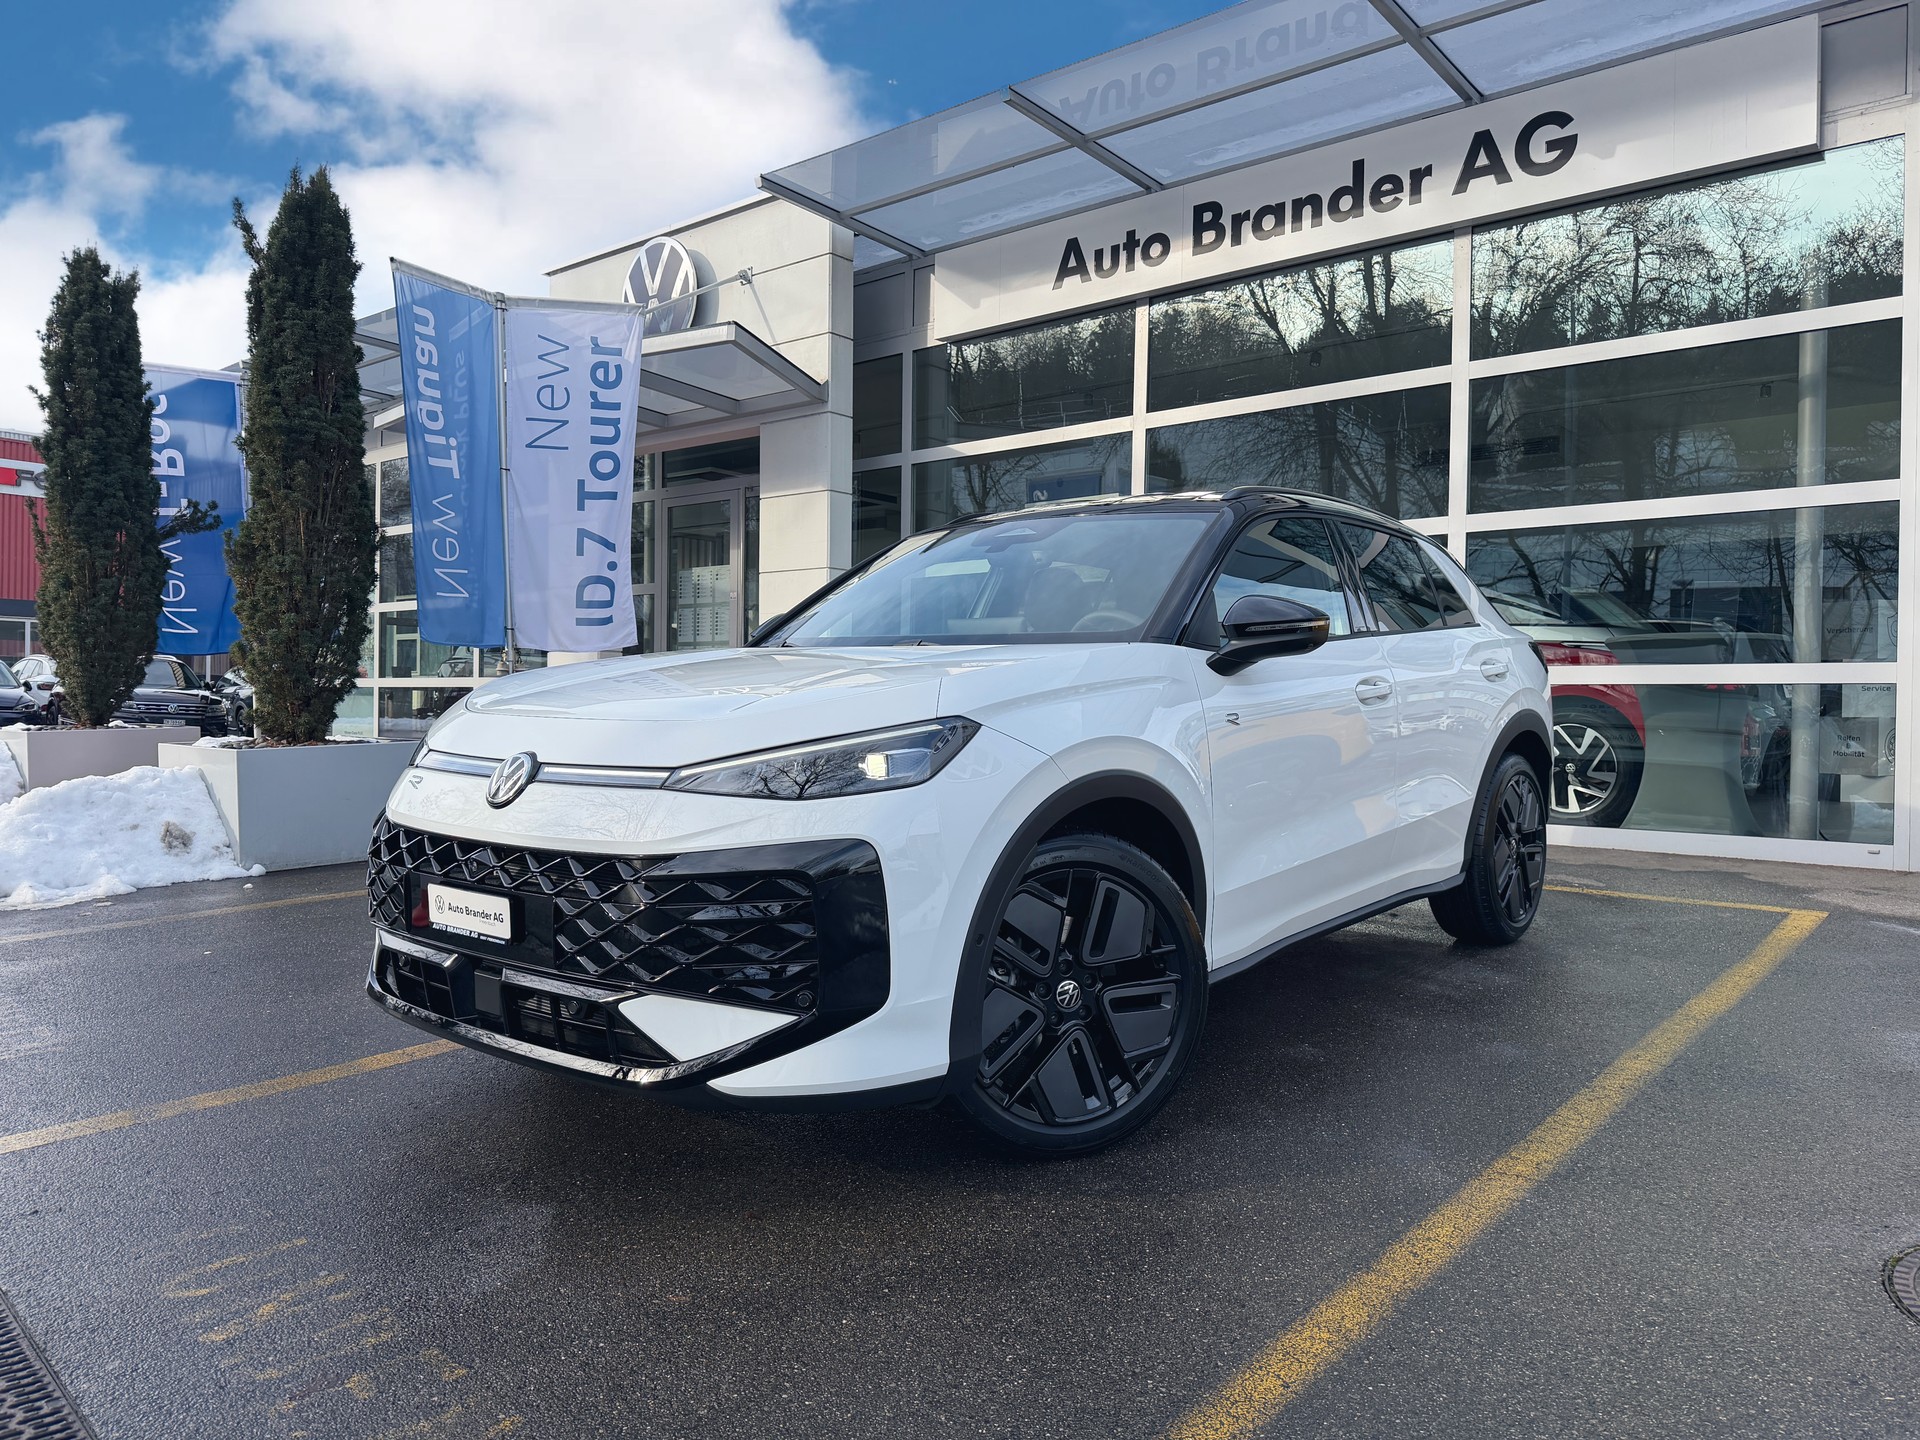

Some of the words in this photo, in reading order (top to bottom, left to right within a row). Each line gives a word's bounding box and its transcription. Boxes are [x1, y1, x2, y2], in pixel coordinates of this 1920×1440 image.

[1052, 229, 1171, 290] Auto
[1192, 158, 1433, 256] Brander
[1452, 110, 1579, 195] AG
[525, 334, 571, 450] New
[576, 335, 623, 511] Tourer
[576, 528, 618, 626] ID.7
[447, 926, 470, 936] BRANDER
[448, 902, 464, 914] Auto
[465, 906, 492, 920] Brander
[494, 912, 504, 923] AG
